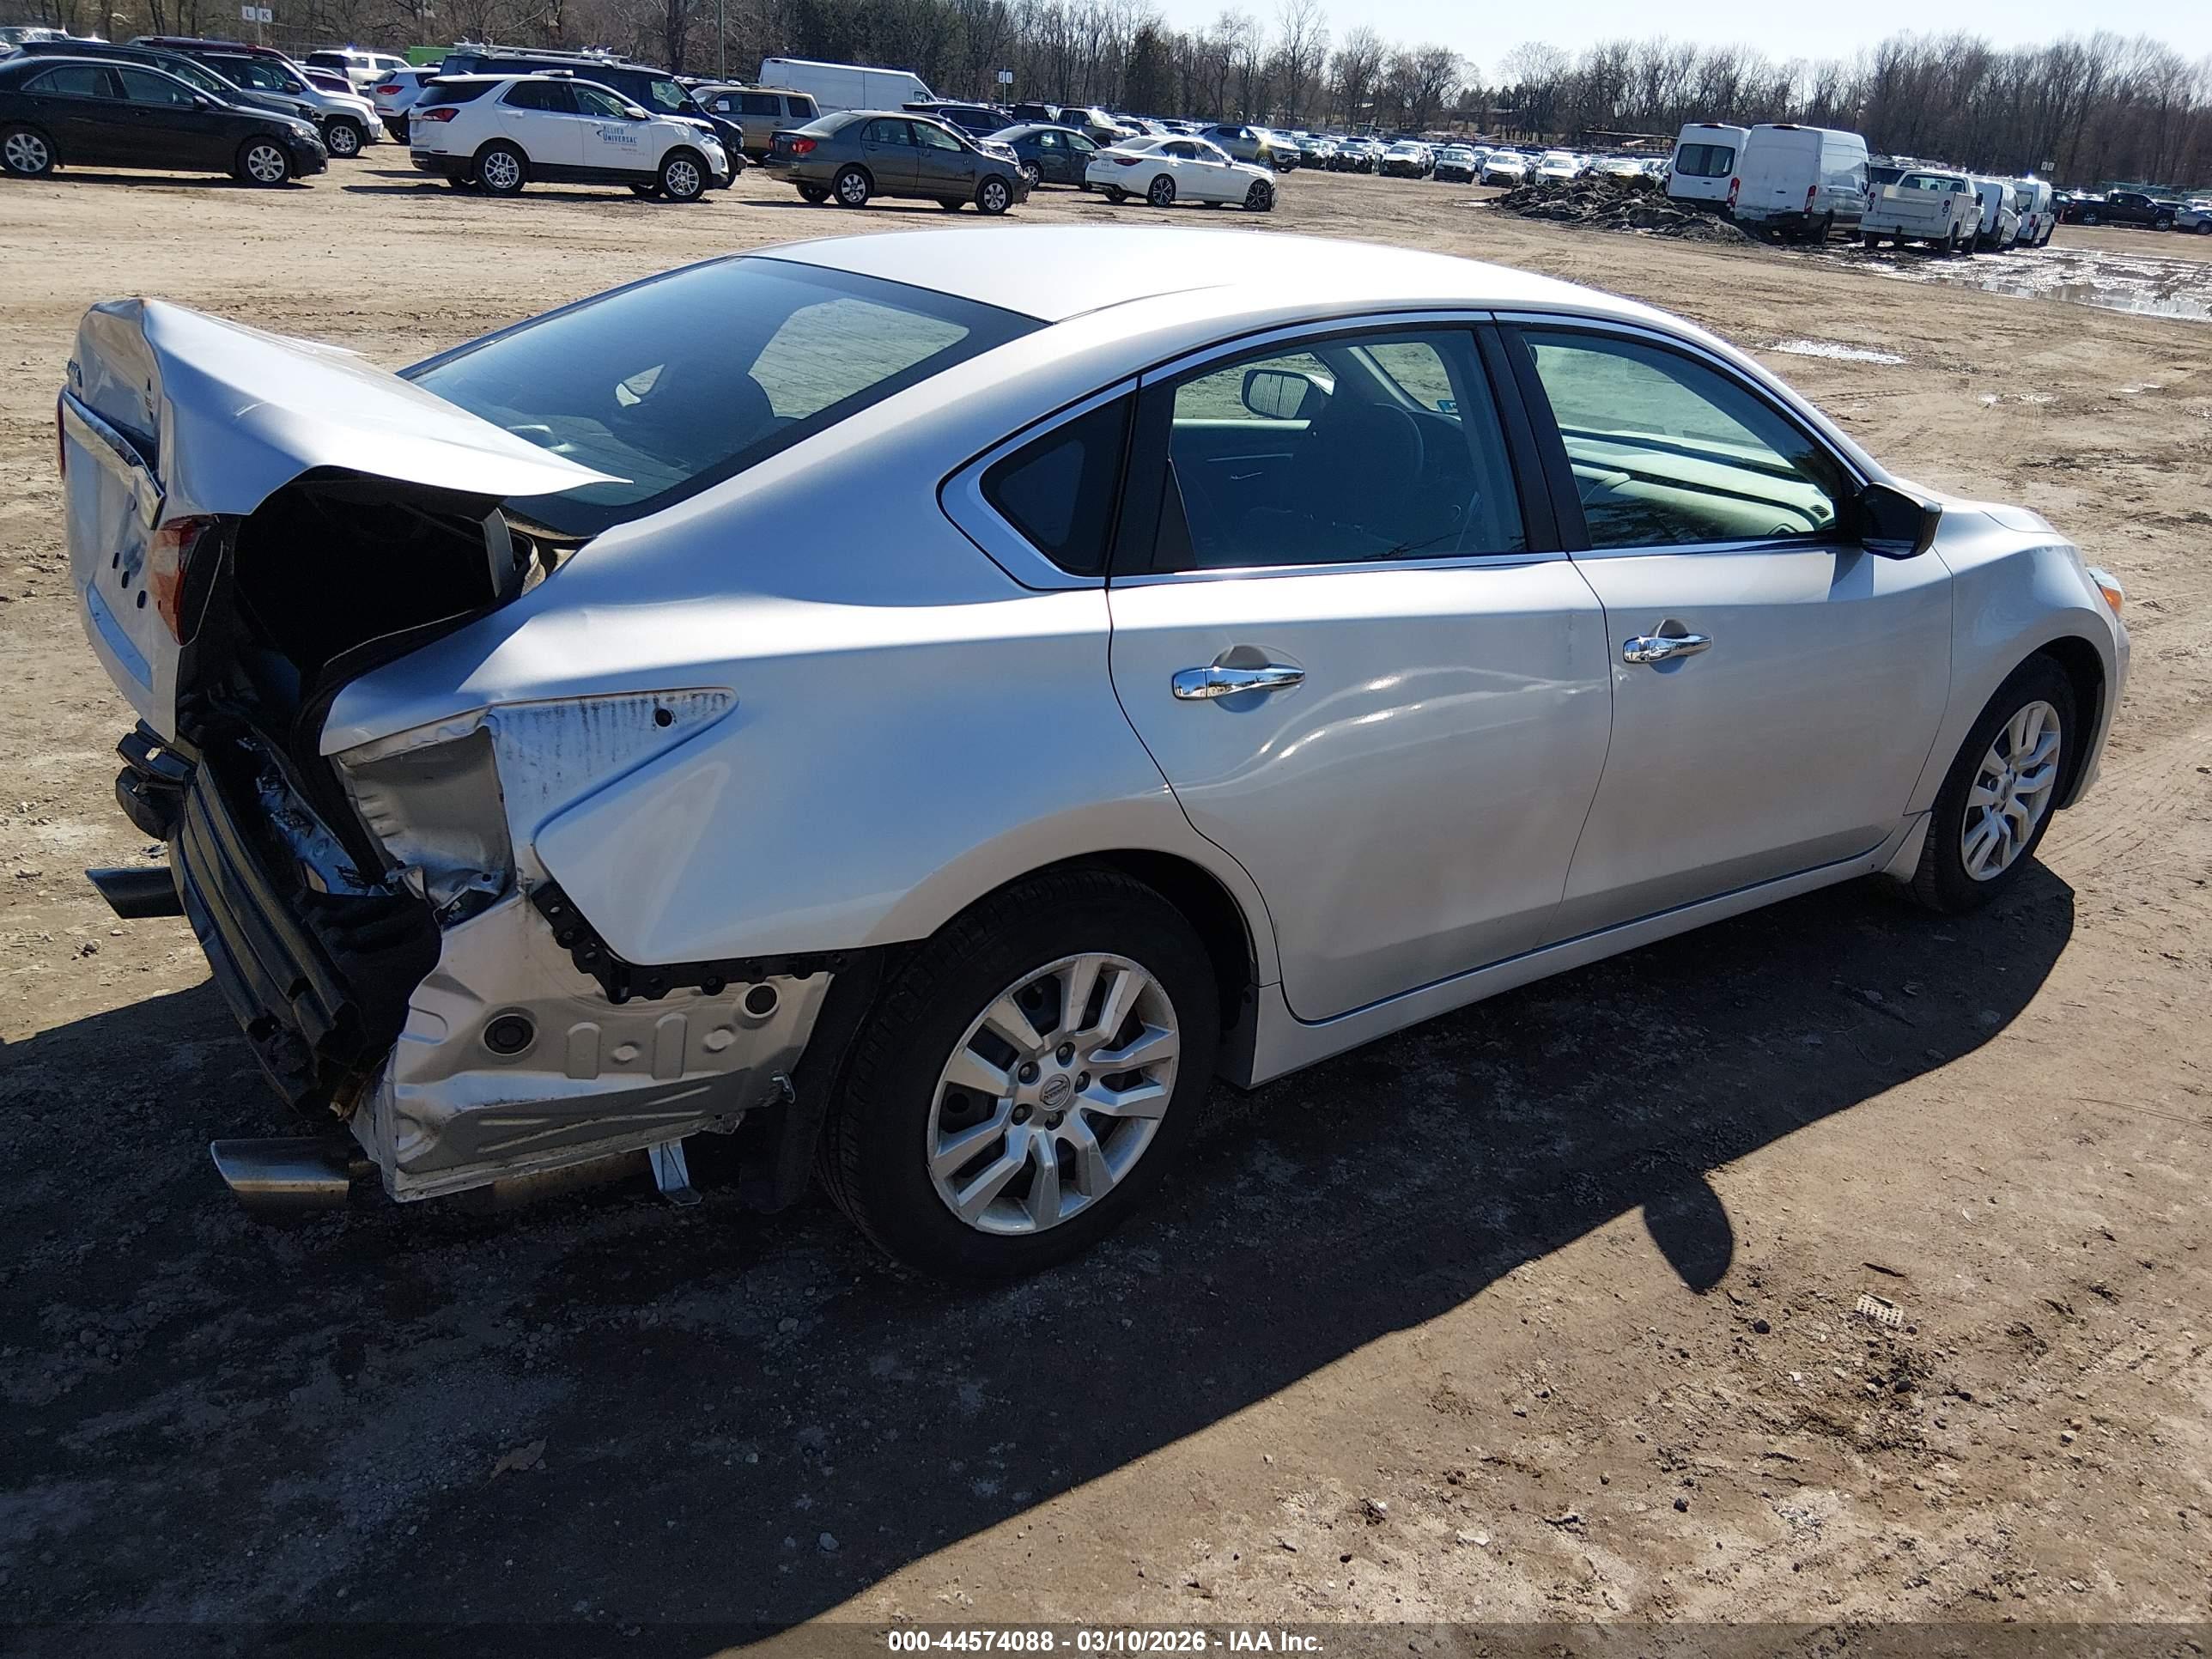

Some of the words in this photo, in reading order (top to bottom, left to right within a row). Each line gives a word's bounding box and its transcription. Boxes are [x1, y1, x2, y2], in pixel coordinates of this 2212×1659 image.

[262, 11, 269, 20] K
[603, 126, 624, 135] ALLIED
[603, 132, 637, 143] UNIVERSAL
